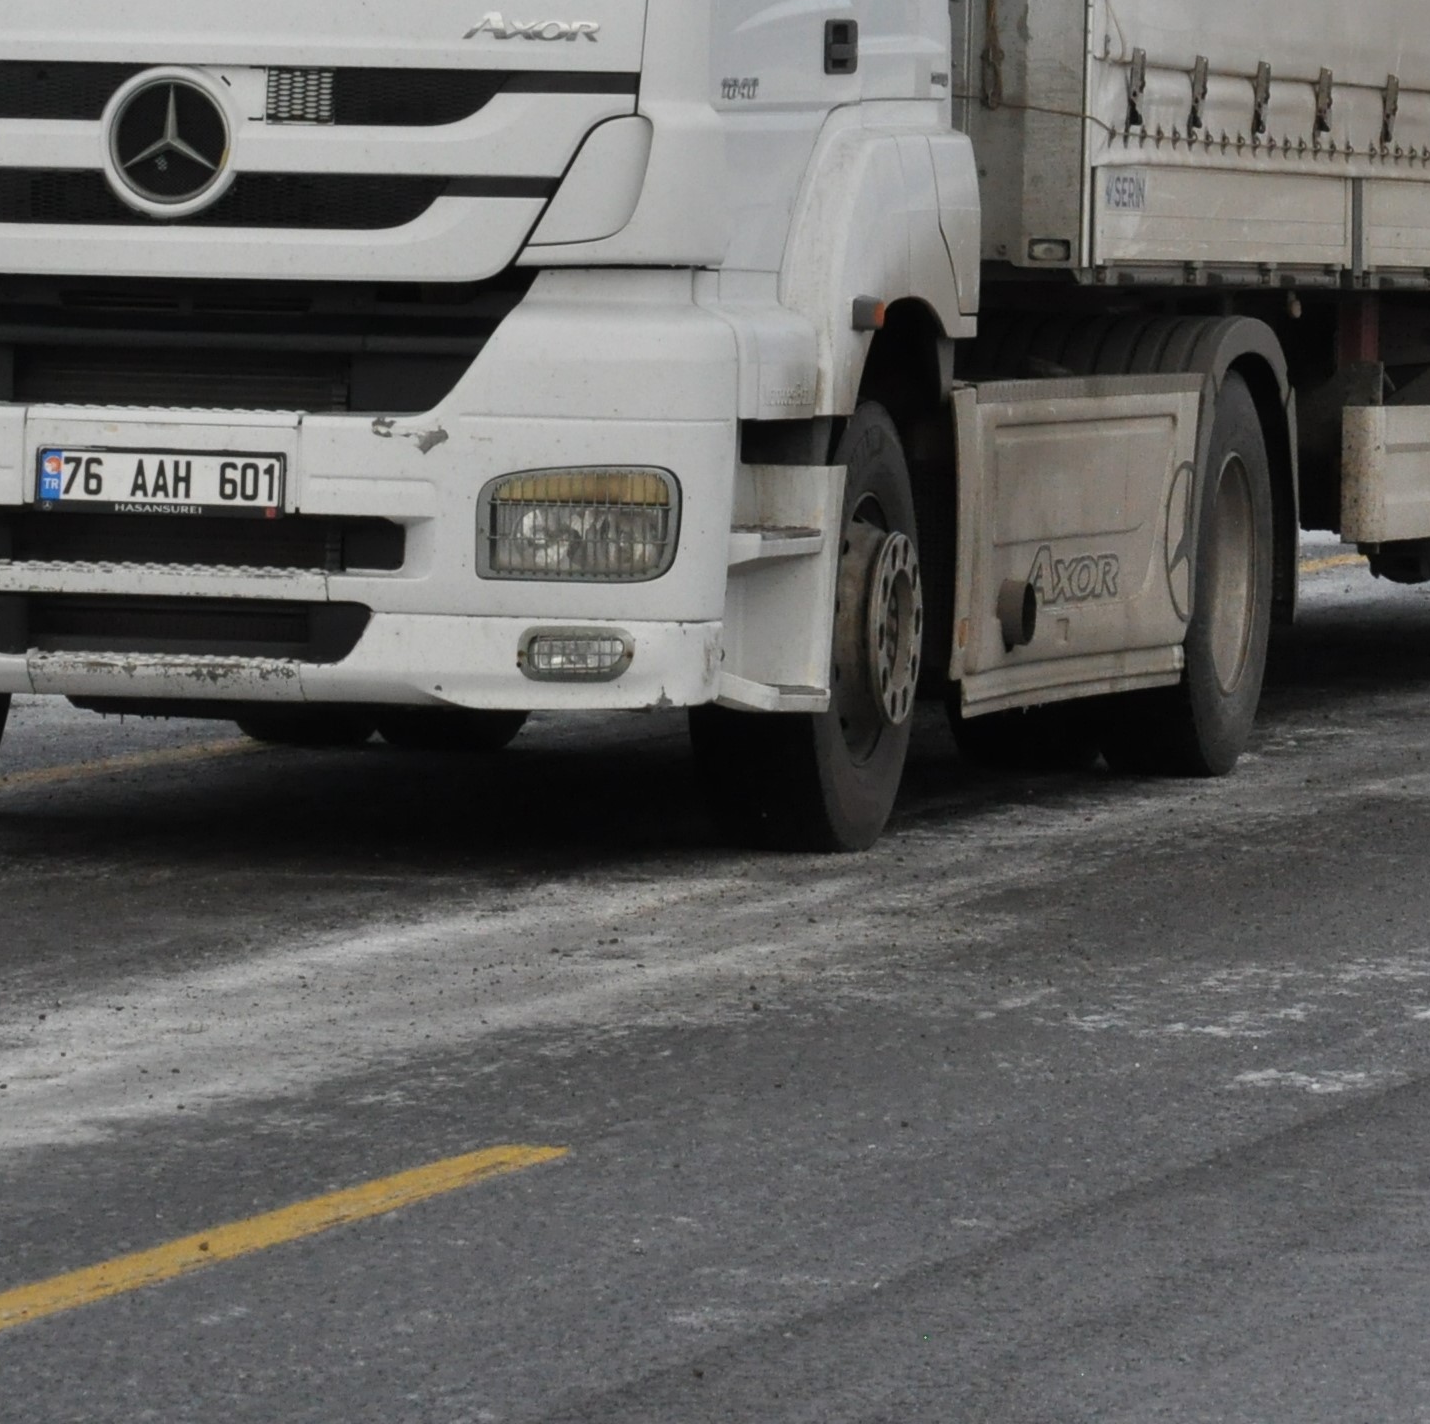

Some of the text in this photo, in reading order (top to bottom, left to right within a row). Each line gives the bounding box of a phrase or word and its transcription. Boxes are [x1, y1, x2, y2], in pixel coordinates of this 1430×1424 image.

[43, 477, 60, 490] TR
[62, 456, 276, 502] 76 AAH 601
